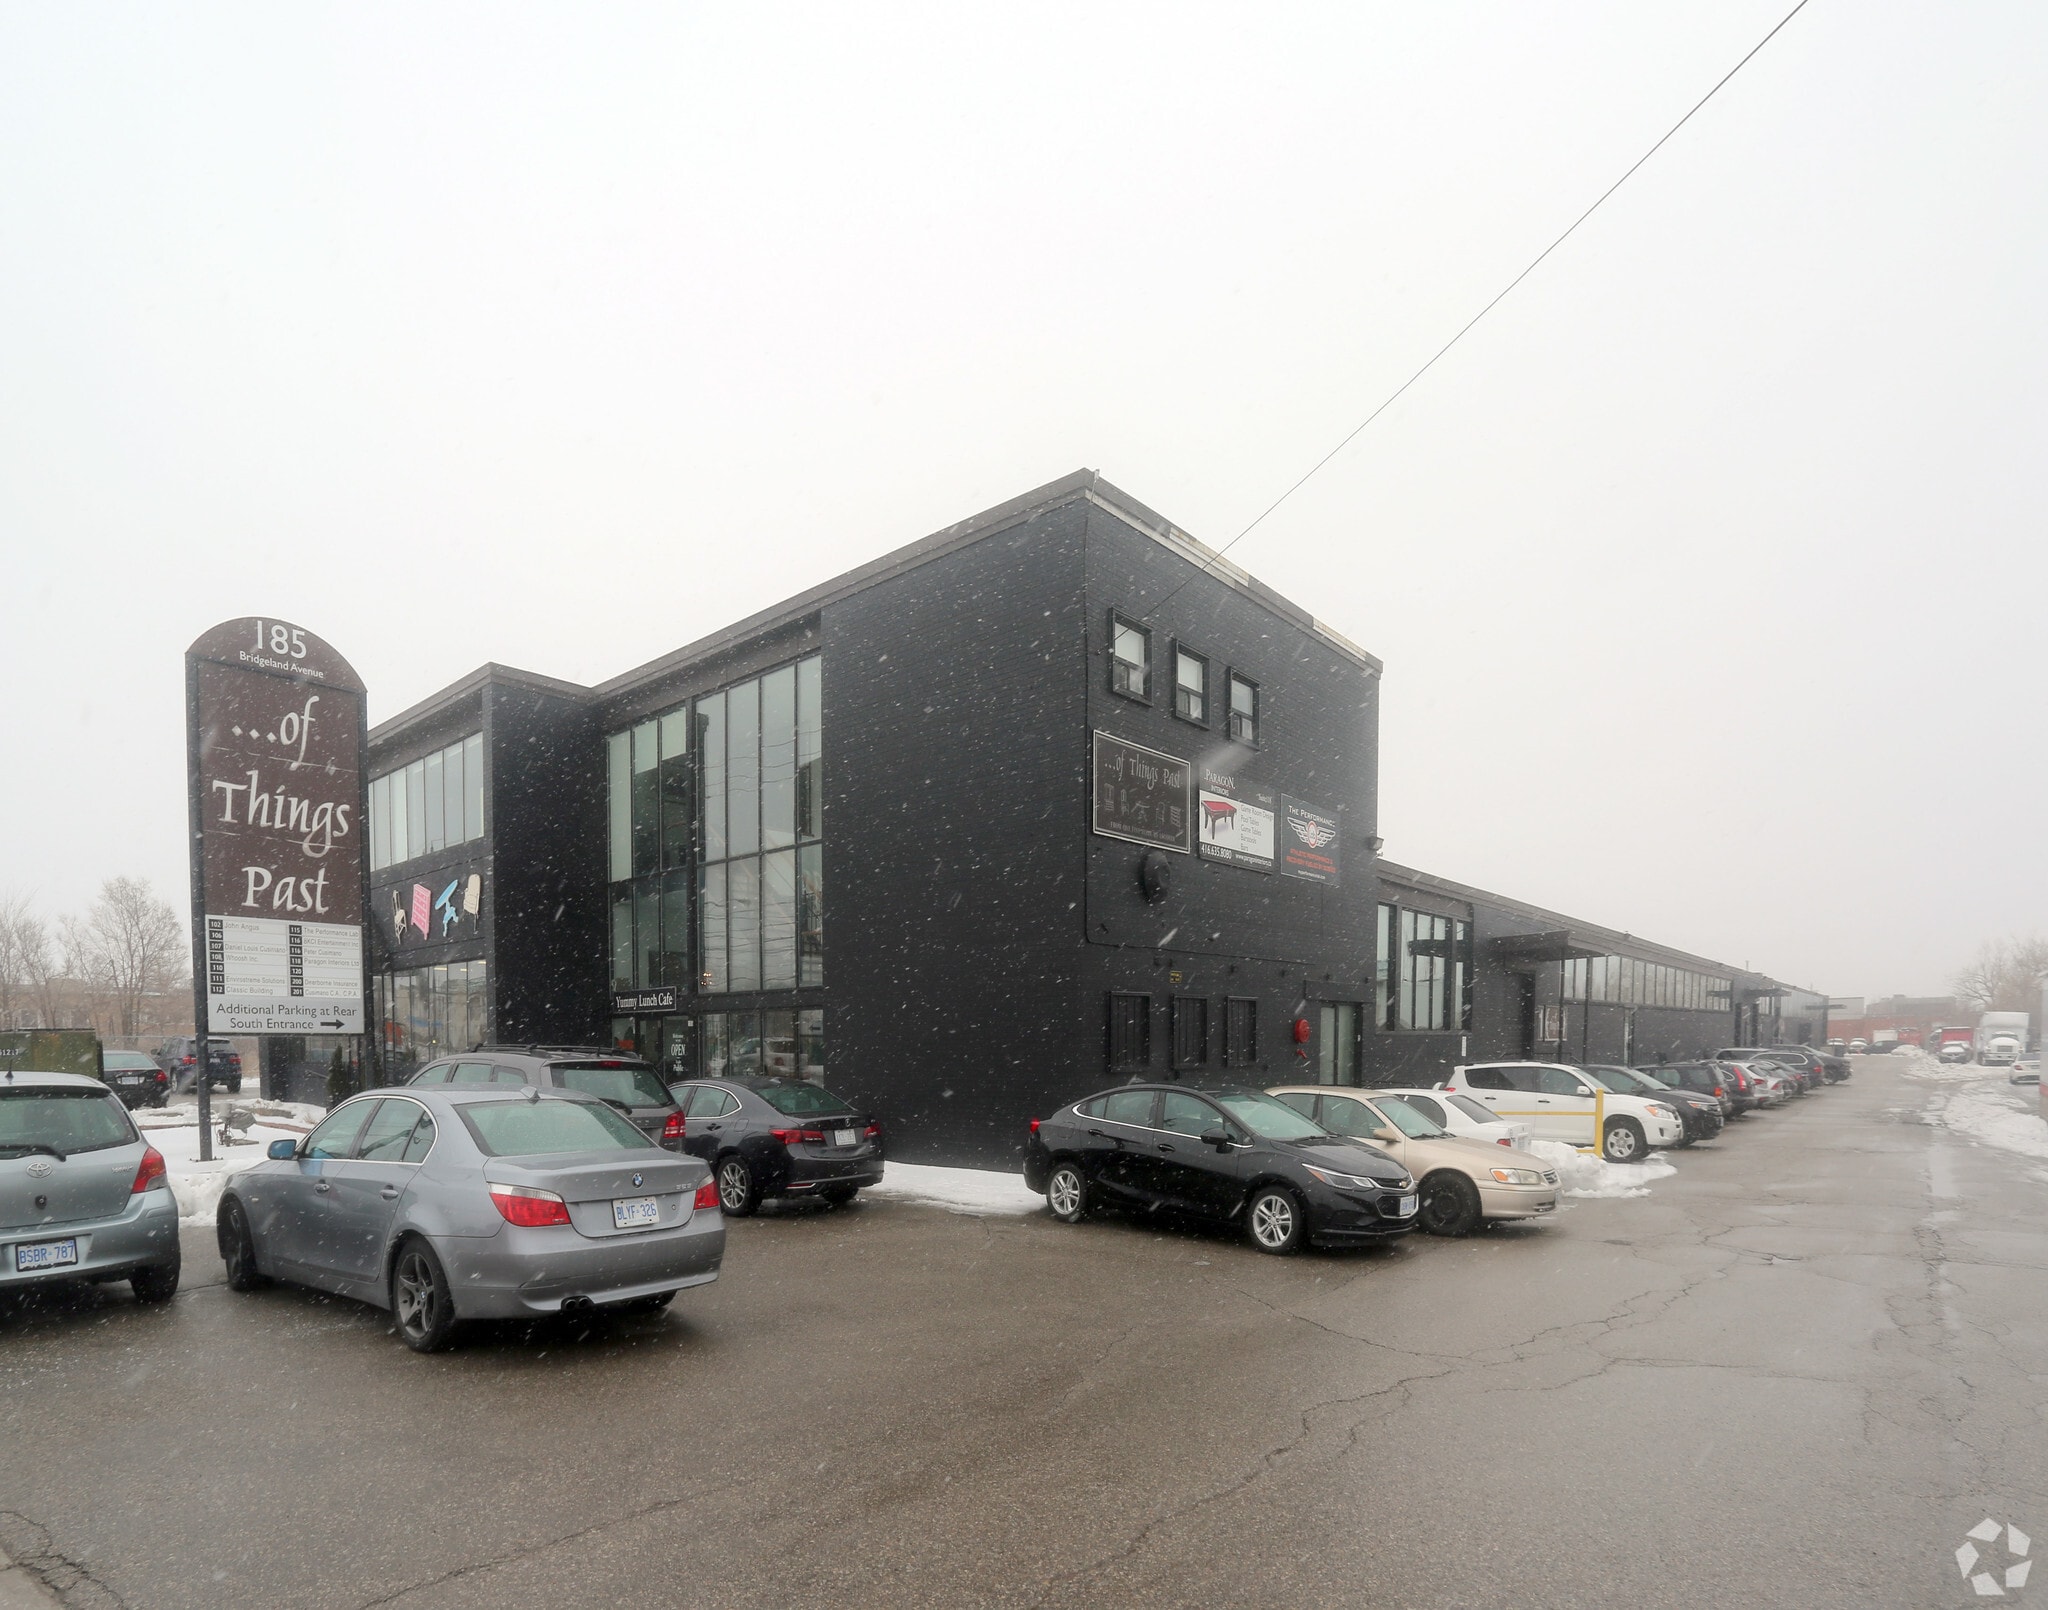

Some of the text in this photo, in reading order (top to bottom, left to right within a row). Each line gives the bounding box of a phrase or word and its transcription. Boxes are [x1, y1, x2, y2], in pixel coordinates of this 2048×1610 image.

[257, 620, 307, 659] 185
[239, 650, 324, 679] Bridgeland Avenue
[1129, 753, 1159, 790] Things
[1163, 768, 1180, 788] Past
[212, 769, 350, 858] Things
[1288, 805, 1299, 815] THE
[241, 866, 330, 914] Past
[241, 924, 260, 932] Angus
[315, 928, 348, 937] Performance
[224, 943, 243, 951] Daniel
[244, 944, 258, 952] Louis
[226, 953, 248, 961] Whoosh
[304, 957, 327, 966] Paragon
[212, 975, 223, 983] 111
[261, 977, 285, 985] Solutions
[333, 979, 358, 987] Insurance
[249, 986, 274, 995] Building
[615, 992, 673, 1010] Yummy Lunch Cafe
[216, 1003, 357, 1018] Additional Parking at Rear
[230, 1017, 314, 1030] South Entrance
[670, 1043, 686, 1056] OPEN
